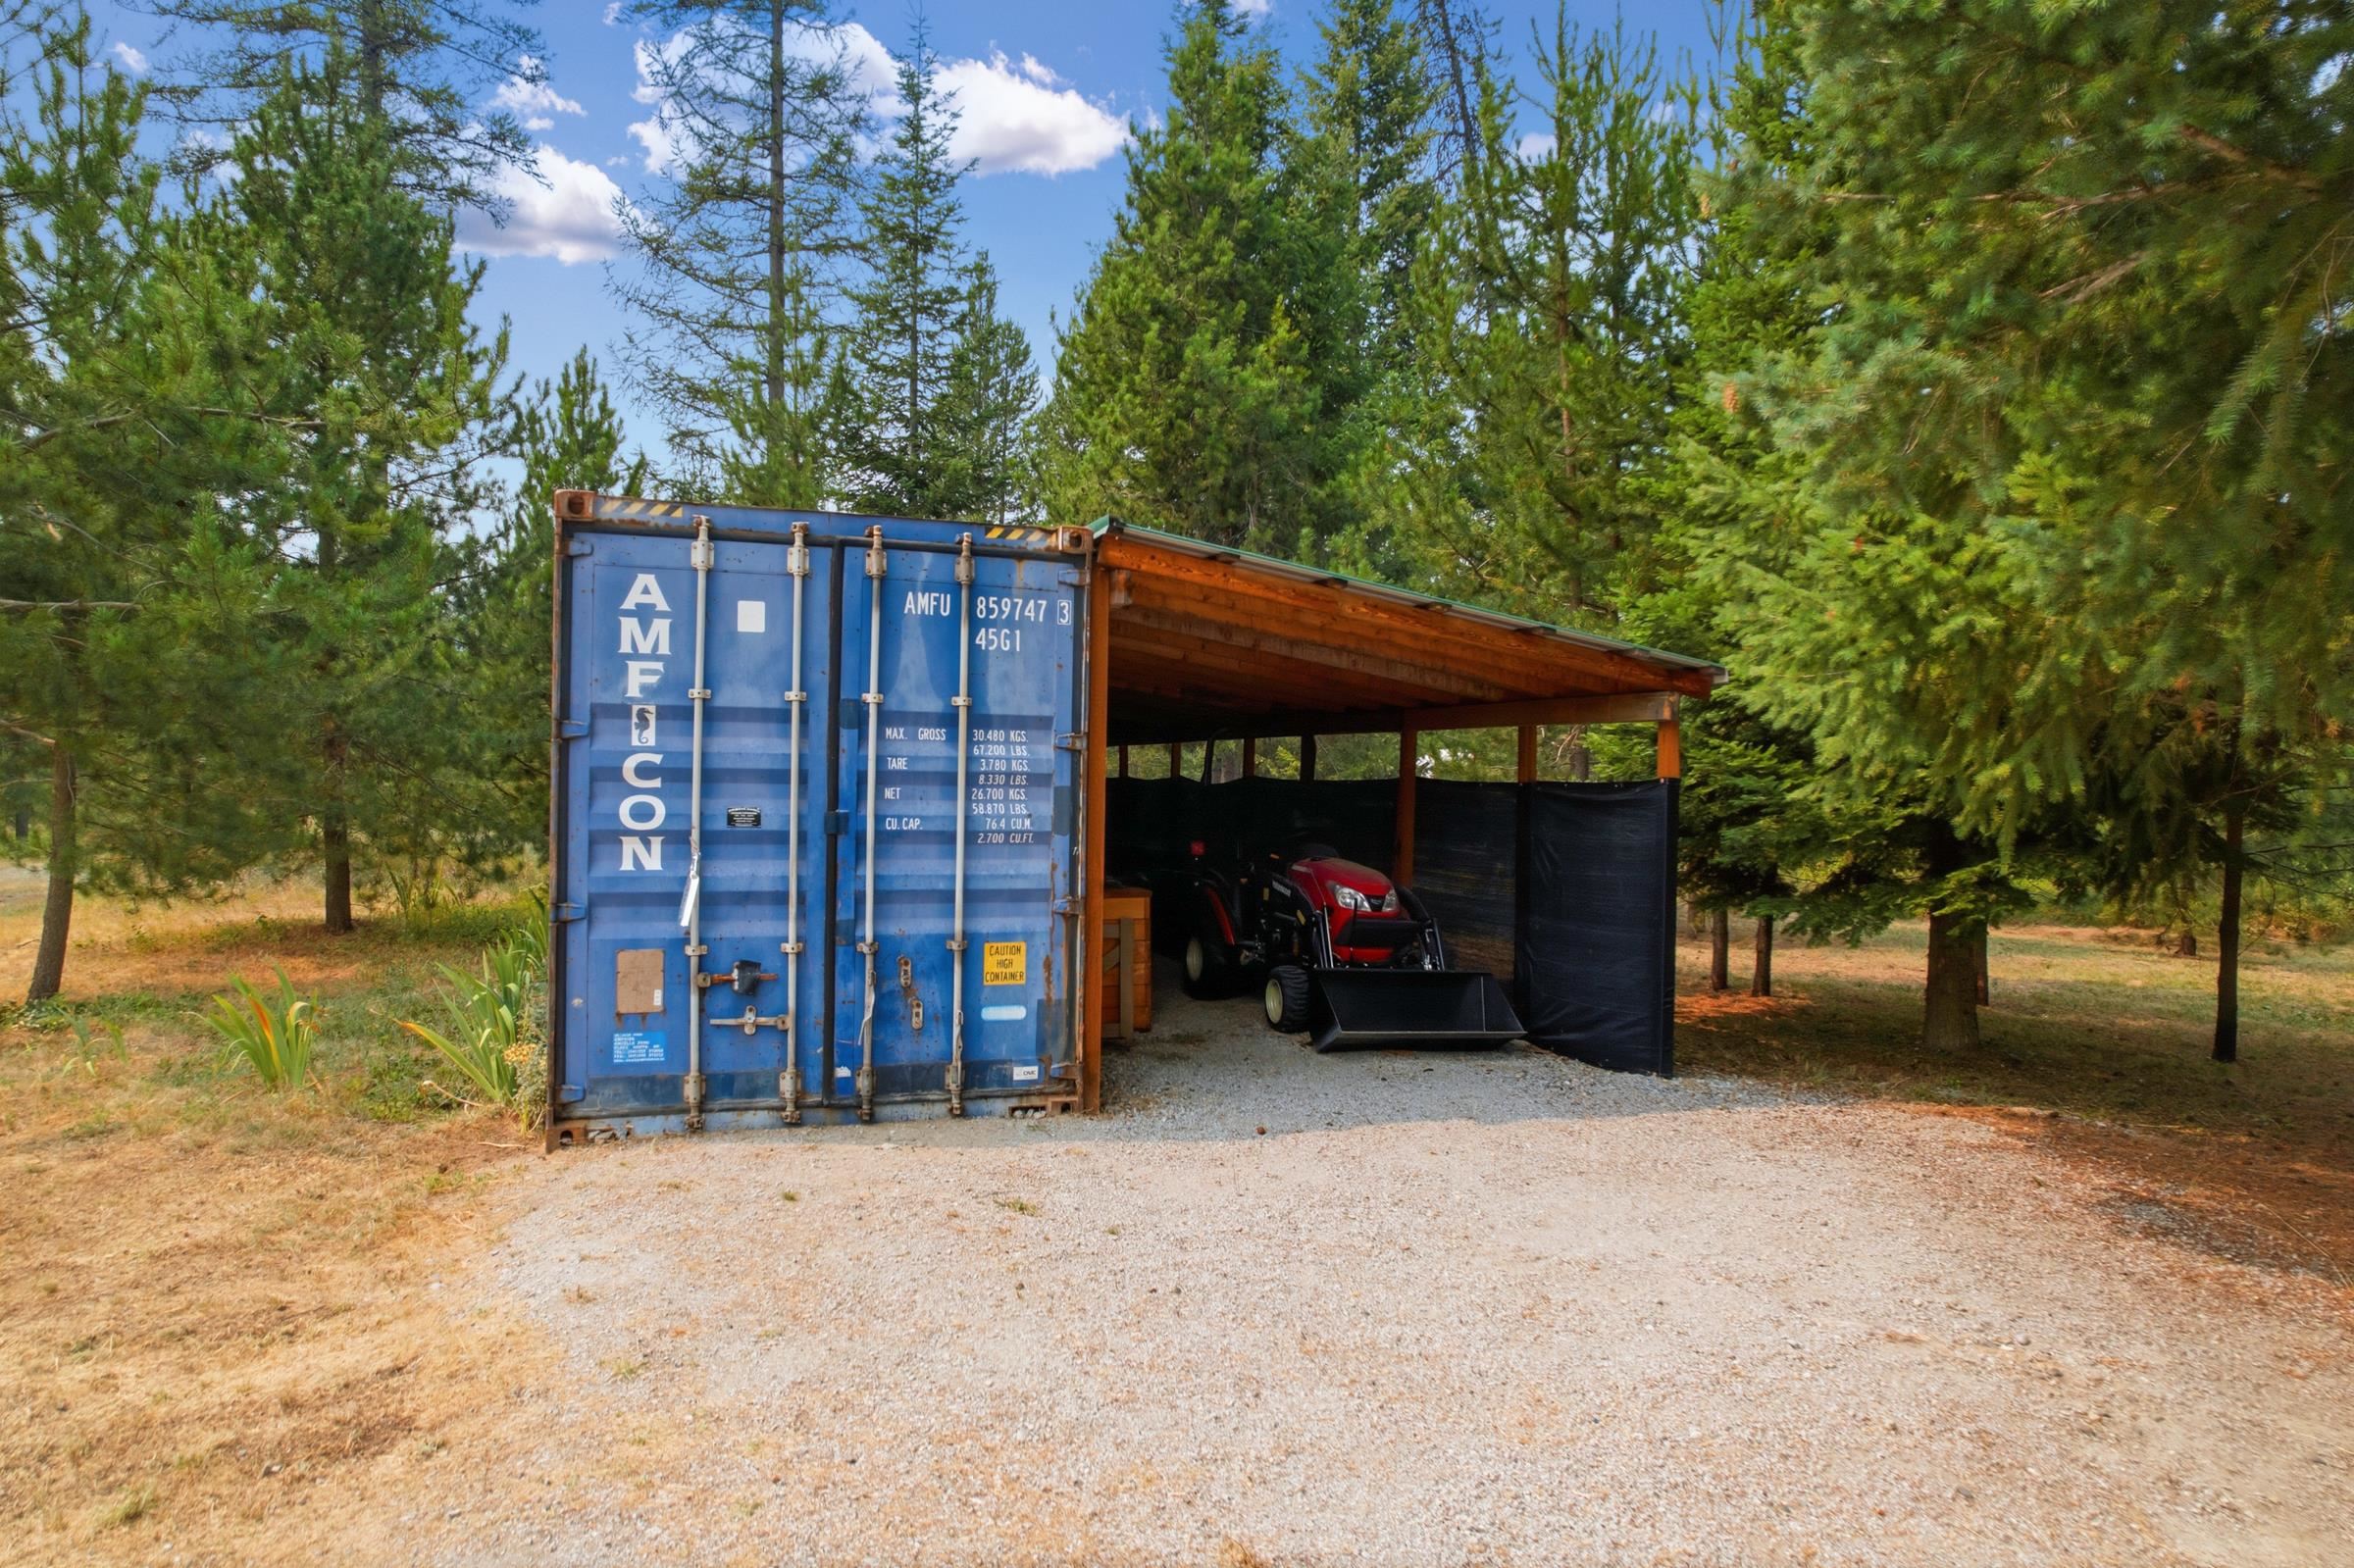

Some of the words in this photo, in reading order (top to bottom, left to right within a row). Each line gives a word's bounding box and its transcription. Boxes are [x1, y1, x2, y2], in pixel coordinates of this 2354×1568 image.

[903, 591, 950, 617] AMFU
[976, 596, 1047, 623] 859747
[1058, 601, 1070, 625] 3
[975, 628, 1021, 652] 45G1
[886, 728, 907, 740] MAX.
[918, 728, 947, 740] GROSS
[973, 730, 1005, 741] 30.480
[1010, 730, 1029, 742] KGS.
[973, 744, 1005, 756] 67.200
[1011, 745, 1030, 756] LBS.
[887, 757, 908, 770] TARE
[980, 759, 1006, 771] 3.780
[1011, 760, 1030, 771] KGS.
[978, 774, 1005, 785] 8.330
[1010, 775, 1029, 785] LBS.
[885, 787, 901, 799] NET
[971, 788, 1004, 800] 26.700
[1009, 788, 1028, 800] KGS.
[973, 803, 1005, 815] 58.870
[1010, 803, 1029, 815] LBS.
[985, 818, 1005, 830] 76.4
[977, 833, 1004, 843] 2.700
[989, 944, 1021, 956] CAUTION
[997, 958, 1013, 969] HIGH
[985, 971, 1024, 983] CONTAINER
